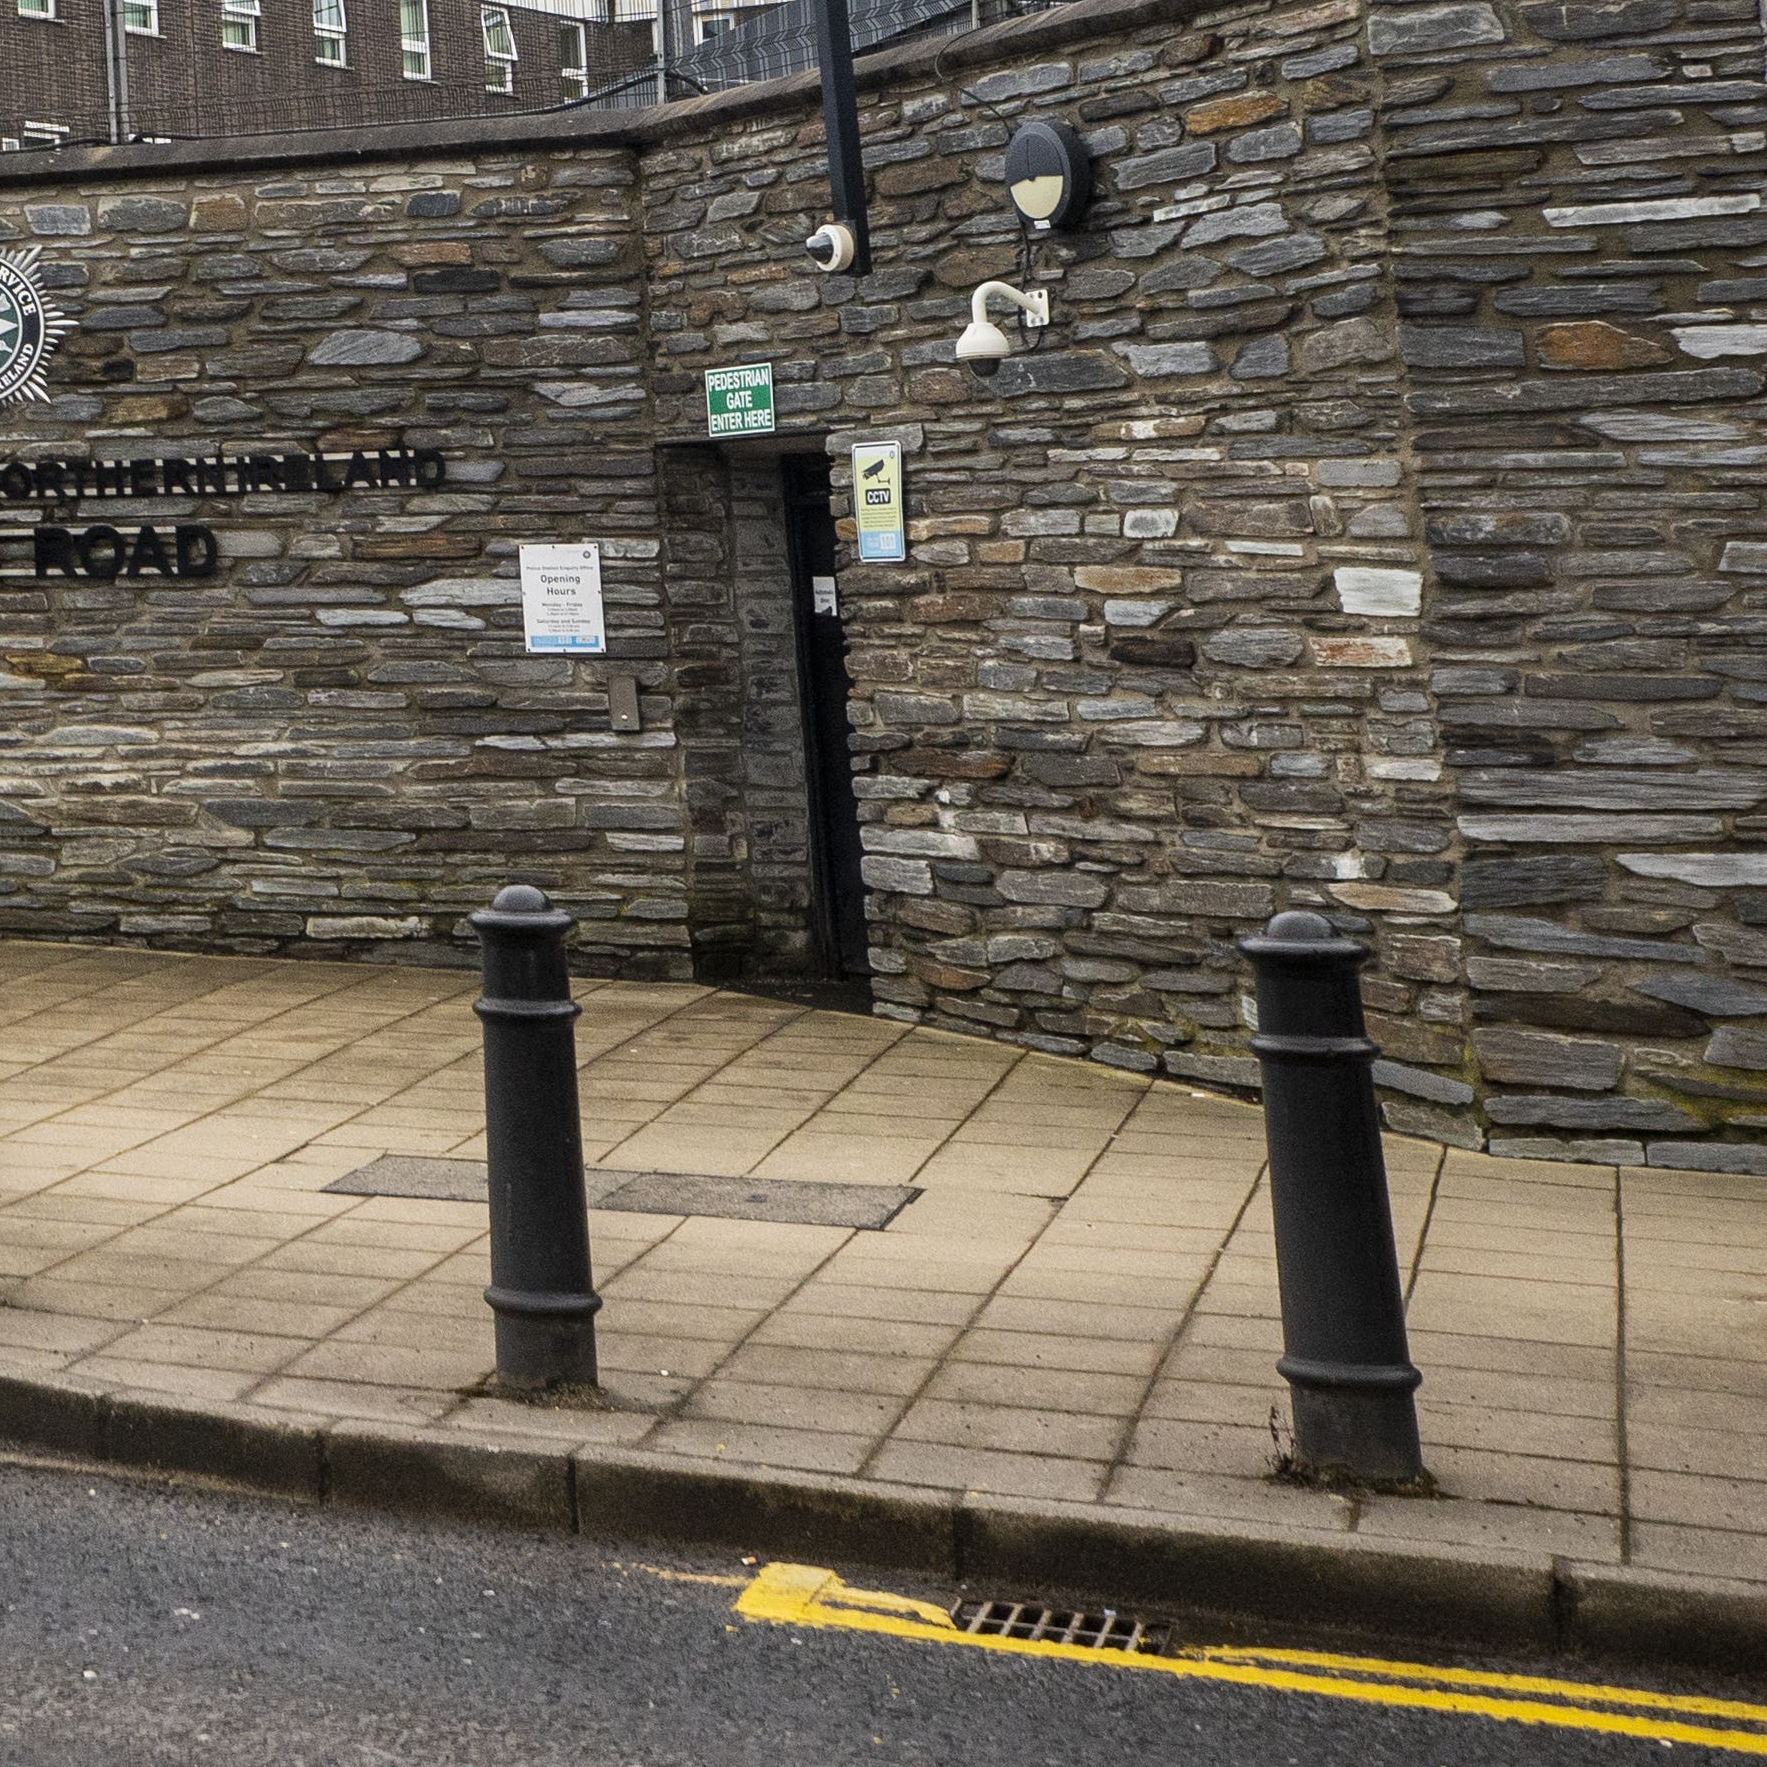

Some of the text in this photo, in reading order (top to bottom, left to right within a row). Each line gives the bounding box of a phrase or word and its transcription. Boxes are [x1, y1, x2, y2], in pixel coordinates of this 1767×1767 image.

[708, 368, 769, 392] PEDESTRIAN
[726, 390, 753, 410] GATE
[711, 409, 772, 431] ENTER HERE
[237, 449, 446, 492] IRELAND
[867, 490, 890, 504] CCTV
[34, 524, 218, 578] ROAD
[540, 574, 581, 584] Opening
[547, 587, 577, 595] Hours
